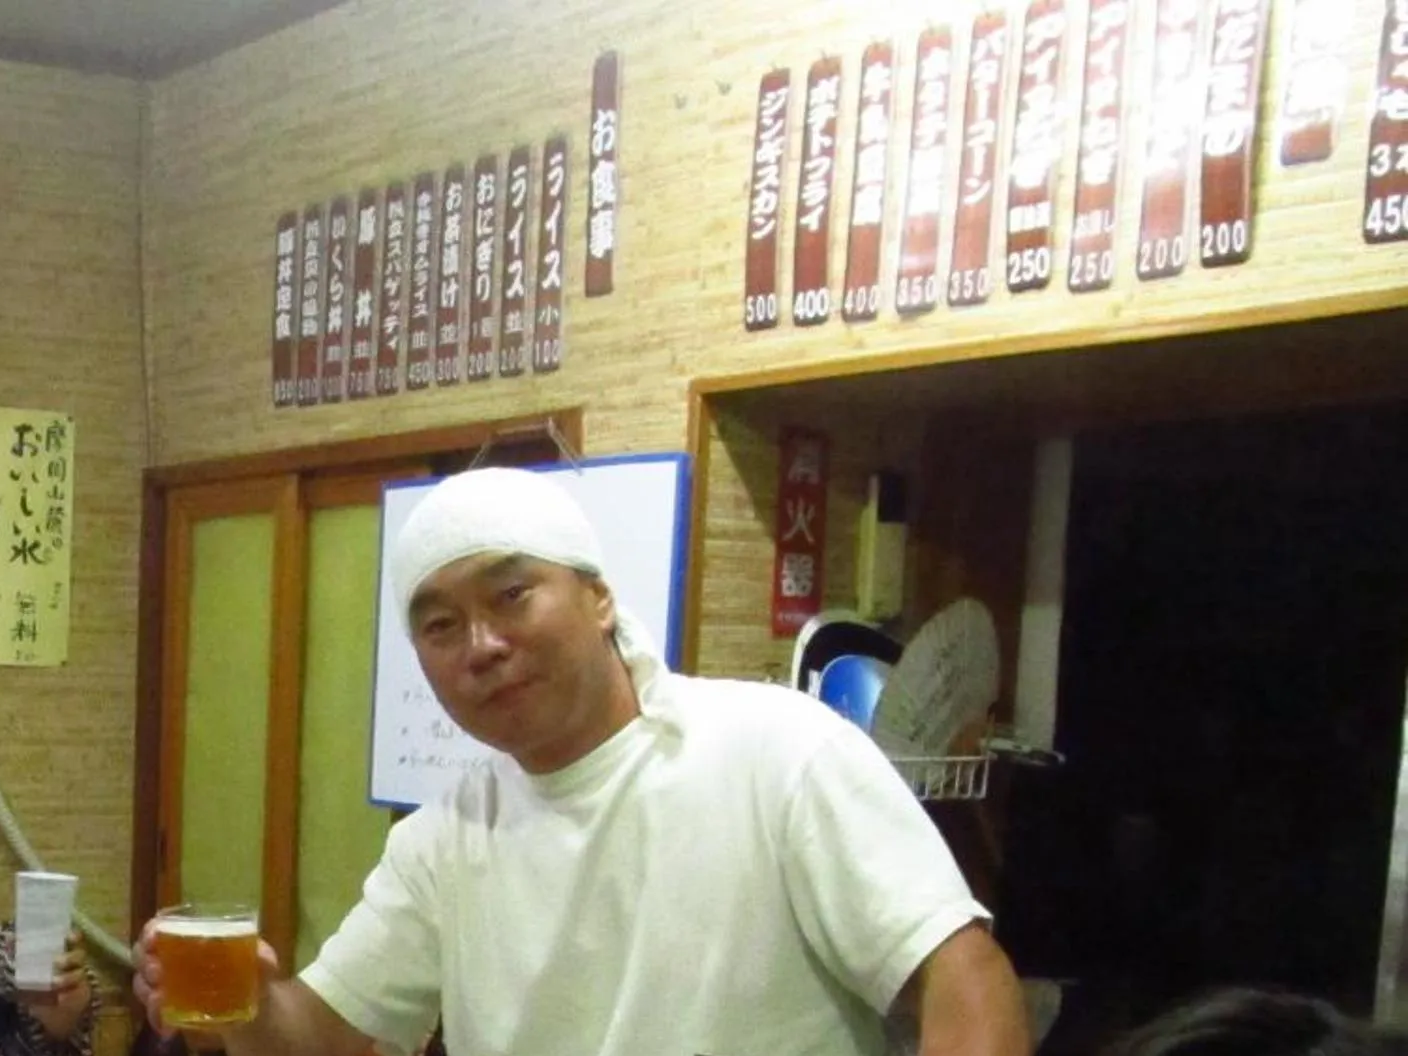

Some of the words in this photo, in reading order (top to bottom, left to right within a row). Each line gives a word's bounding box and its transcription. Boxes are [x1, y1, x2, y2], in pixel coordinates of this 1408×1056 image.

[963, 28, 1005, 206] バターコーン
[751, 87, 788, 240] ジンギスカン
[798, 75, 840, 232] ポテトフライ
[475, 173, 496, 301] おにぎり
[505, 165, 528, 299] ライス
[541, 152, 565, 290] ライス
[1140, 235, 1184, 272] 200
[1203, 220, 1246, 258] 200
[1009, 247, 1050, 285] 250
[1070, 252, 1113, 285] 250
[843, 285, 878, 315] 400
[896, 277, 936, 307] 350
[949, 269, 989, 300] 350
[538, 305, 559, 326] 小
[746, 294, 776, 322] 500
[794, 288, 829, 318] 400
[504, 311, 524, 335] 並
[468, 353, 492, 376] 200
[535, 338, 561, 366] 100
[436, 358, 457, 381] 300
[8, 422, 45, 565] おいしい水
